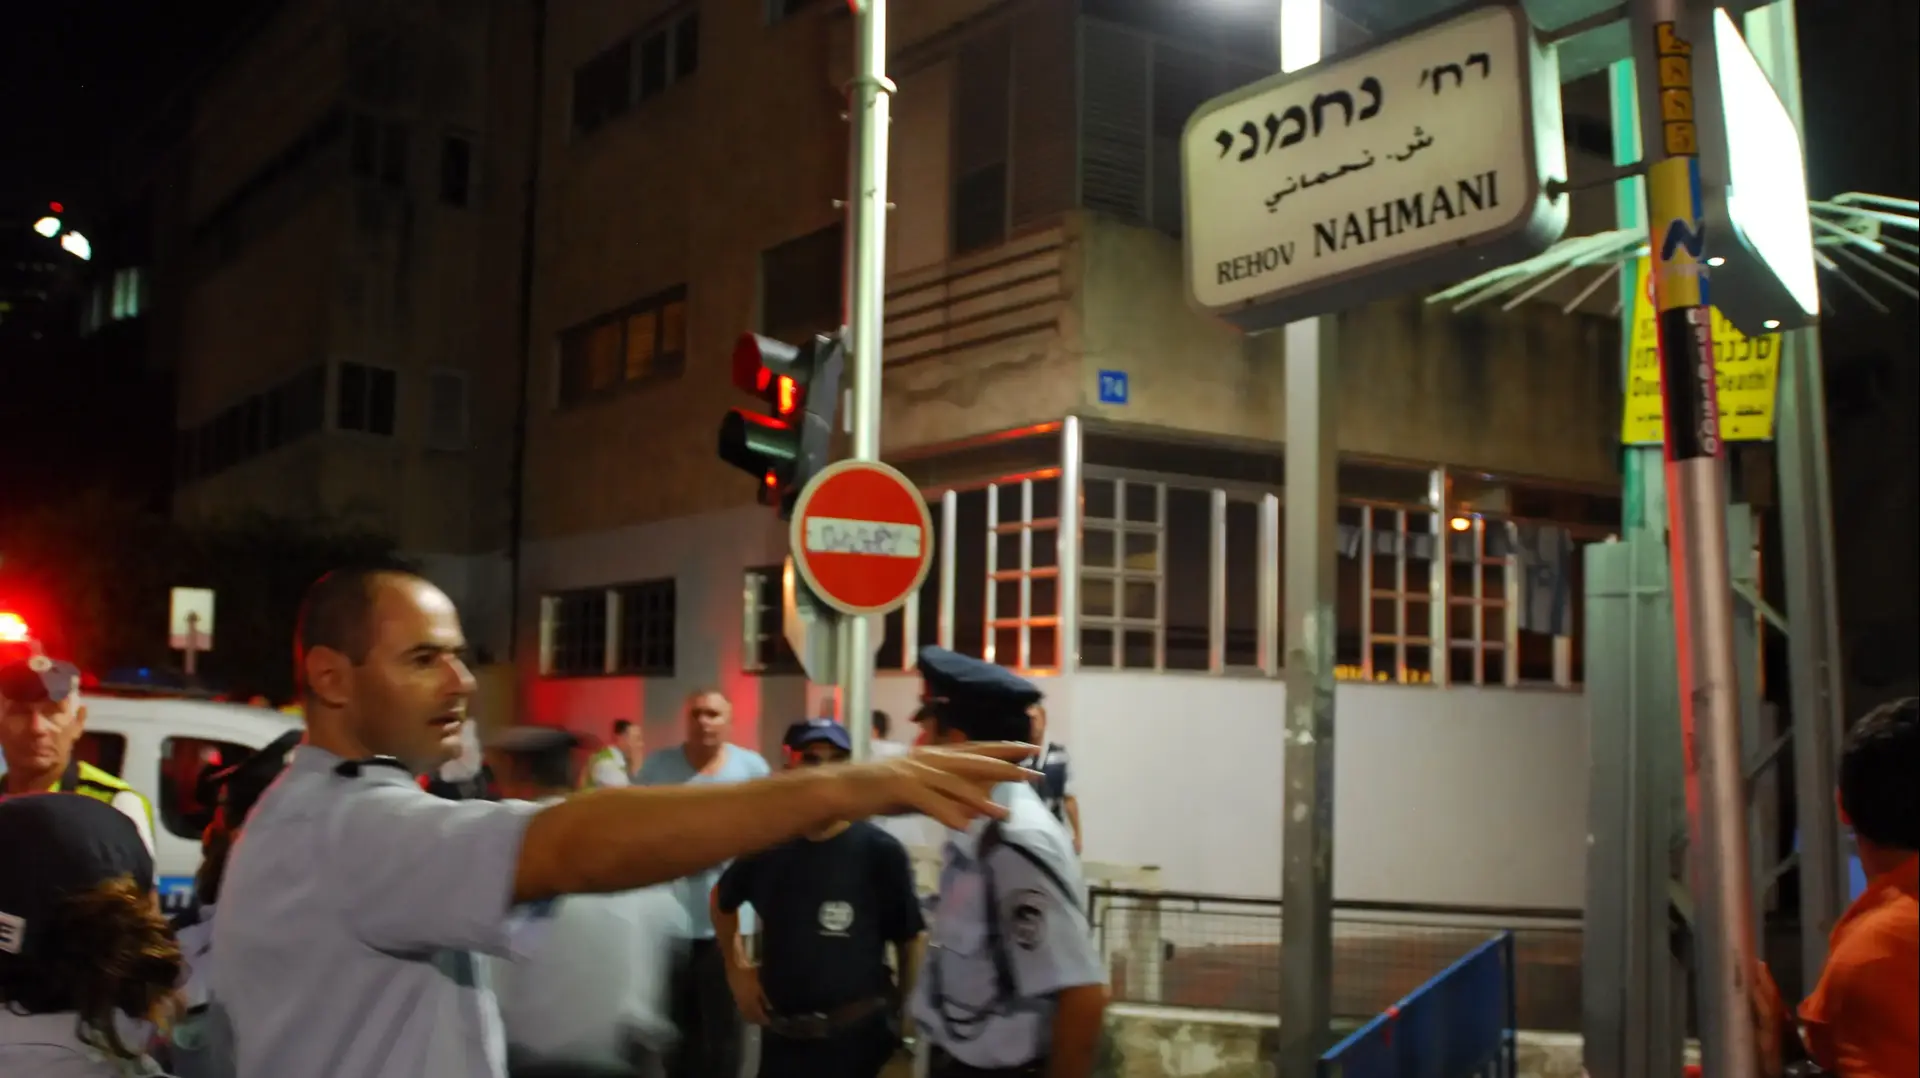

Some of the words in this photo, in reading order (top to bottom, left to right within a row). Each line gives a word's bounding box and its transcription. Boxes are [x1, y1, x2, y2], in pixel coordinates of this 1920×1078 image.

[1215, 76, 1383, 162] נחמני
[1216, 242, 1295, 285] REHOV
[1313, 171, 1499, 257] NAHMANI
